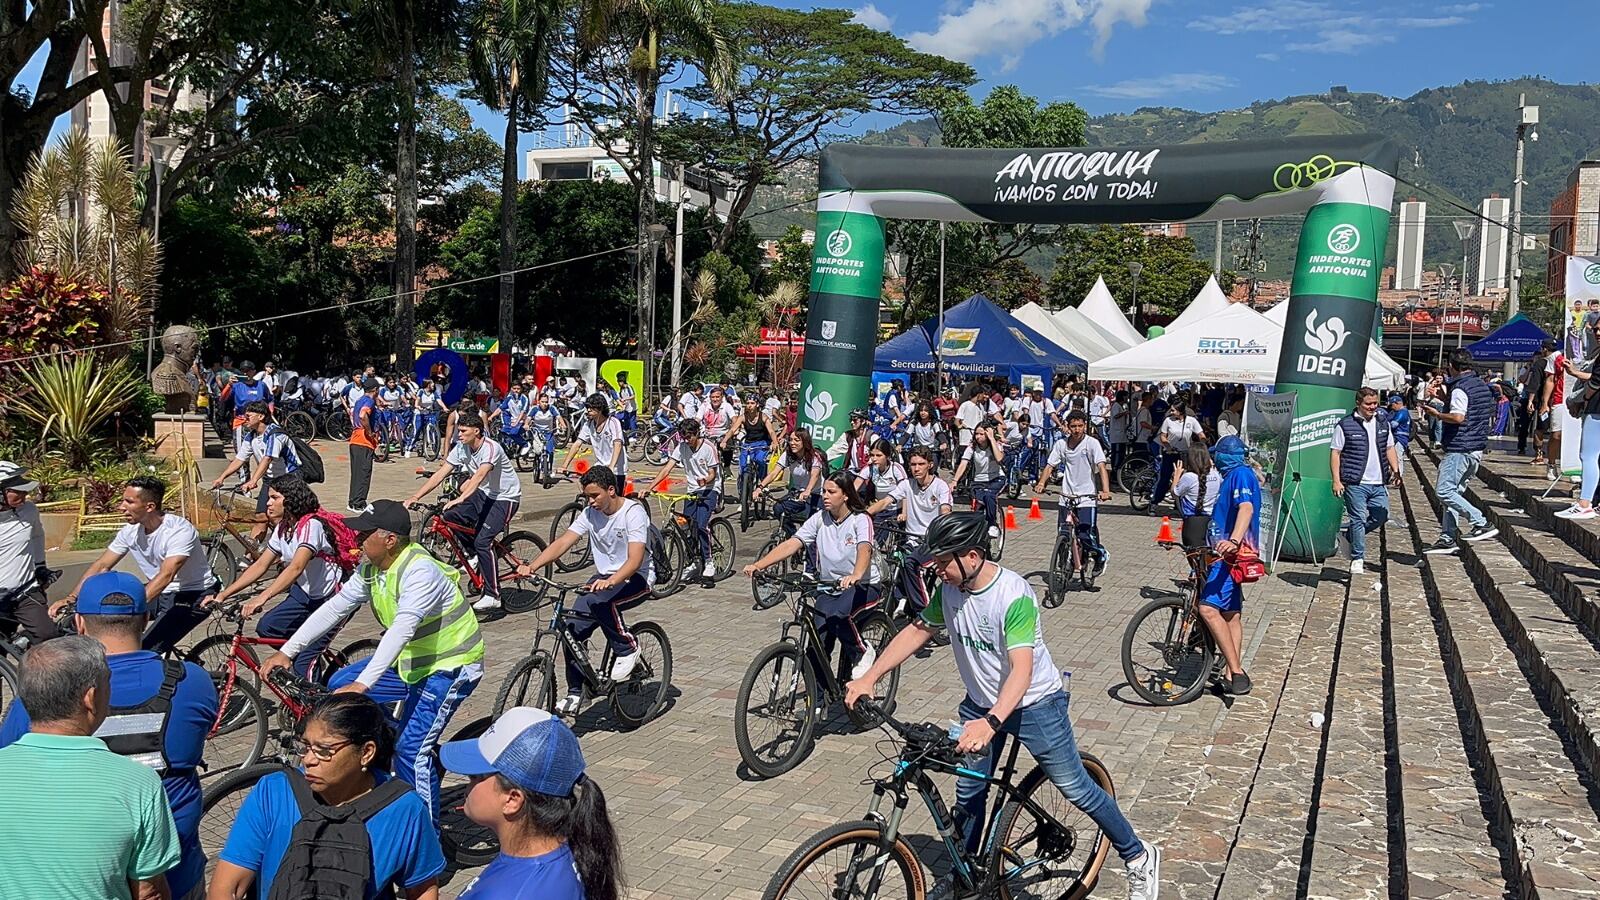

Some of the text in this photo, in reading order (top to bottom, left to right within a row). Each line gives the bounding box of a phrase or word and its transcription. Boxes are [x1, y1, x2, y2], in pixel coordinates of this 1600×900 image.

[995, 149, 1160, 183] ANTIOQUIA
[1062, 184, 1098, 201] CON
[1106, 181, 1158, 200] TODA!
[816, 257, 864, 267] INDEPORTES
[1309, 255, 1372, 267] INDEPORTES
[816, 266, 860, 277] ANTIOQUIA
[1309, 266, 1367, 278] ANTIOQUIA
[1198, 340, 1236, 348] BICI
[951, 362, 995, 373] Movilidad
[1297, 354, 1346, 377] IDEA
[801, 422, 836, 441] DEA
